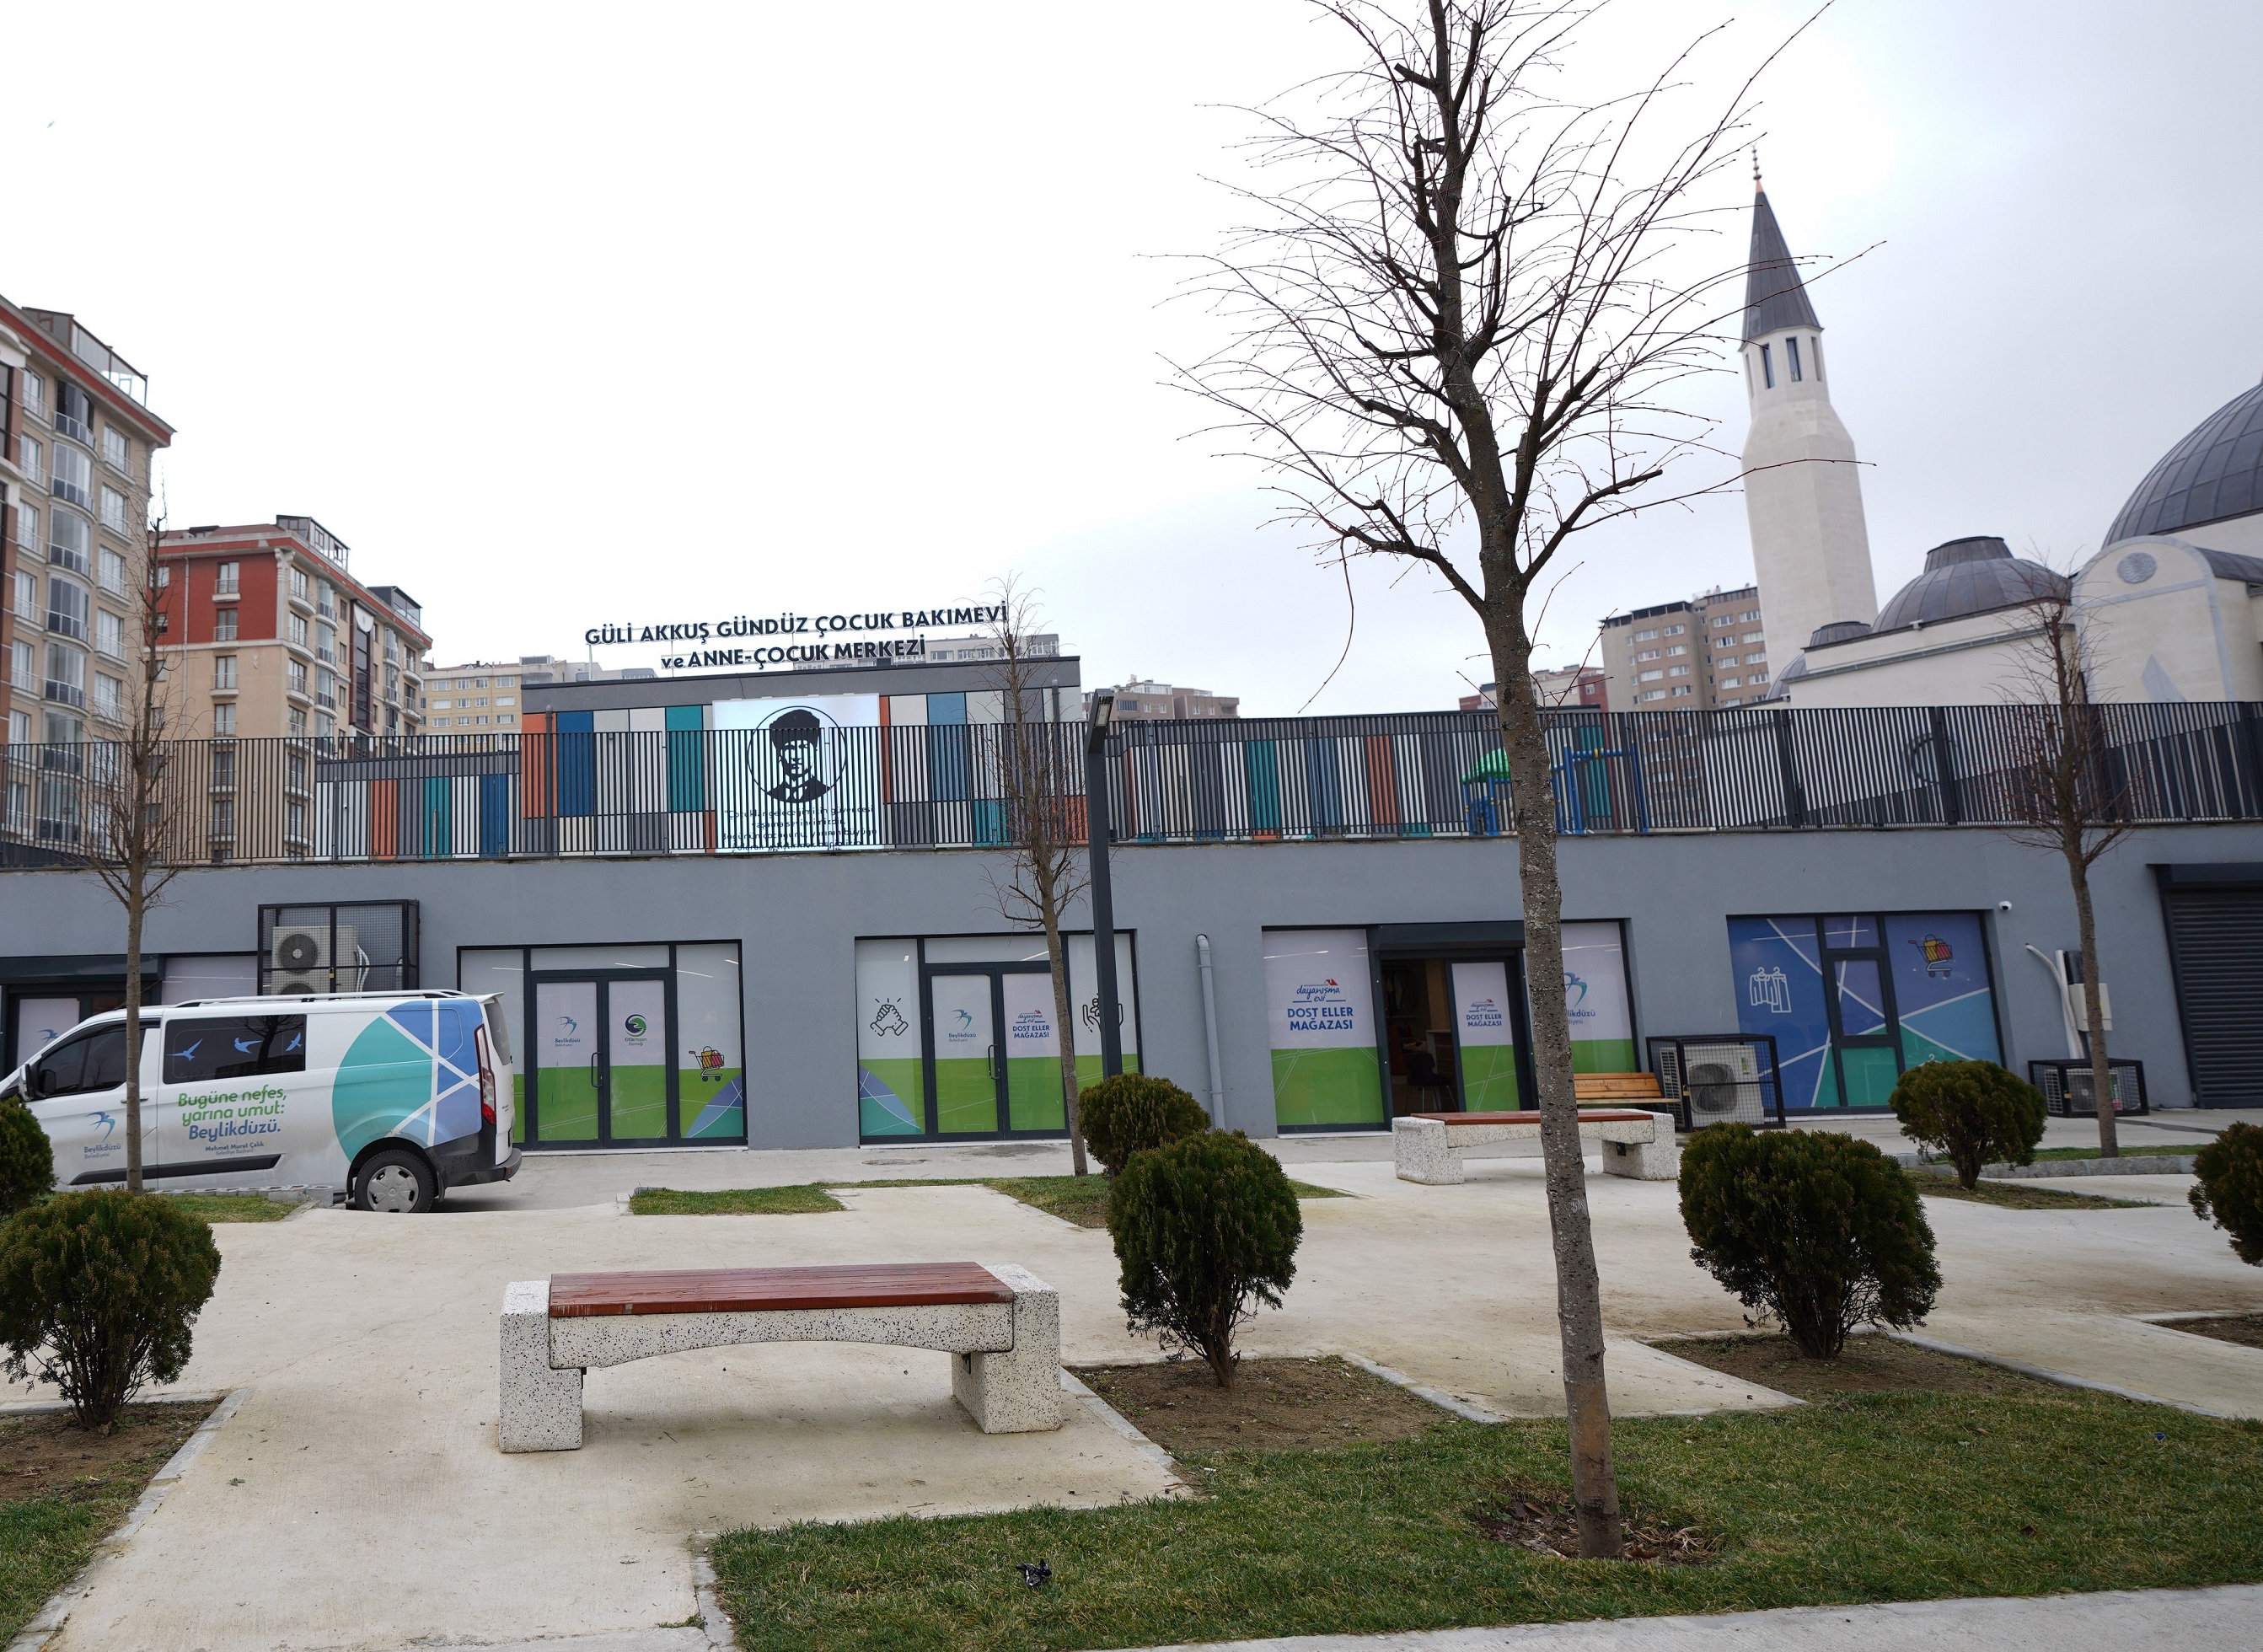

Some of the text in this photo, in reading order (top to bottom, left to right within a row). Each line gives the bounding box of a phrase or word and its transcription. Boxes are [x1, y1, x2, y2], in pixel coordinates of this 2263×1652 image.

[585, 599, 1007, 645] GÜLİ AKKUŞ GÜNDÜZ ÇOCUK BAKIMEVİ
[662, 634, 925, 670] ve ANNE-ÇOCUK MERKEZİ
[1296, 985, 1341, 1000] dayanışma
[1313, 994, 1327, 1002] evi
[1287, 1007, 1354, 1018] DOST ELLER
[1290, 1017, 1353, 1031] MAĞAZASI
[178, 1084, 287, 1109] Bugüne nefes,
[182, 1100, 285, 1127] yarına umut:
[189, 1118, 282, 1142] Beylikdüzü.
[84, 1144, 121, 1153] Beylikdüzü
